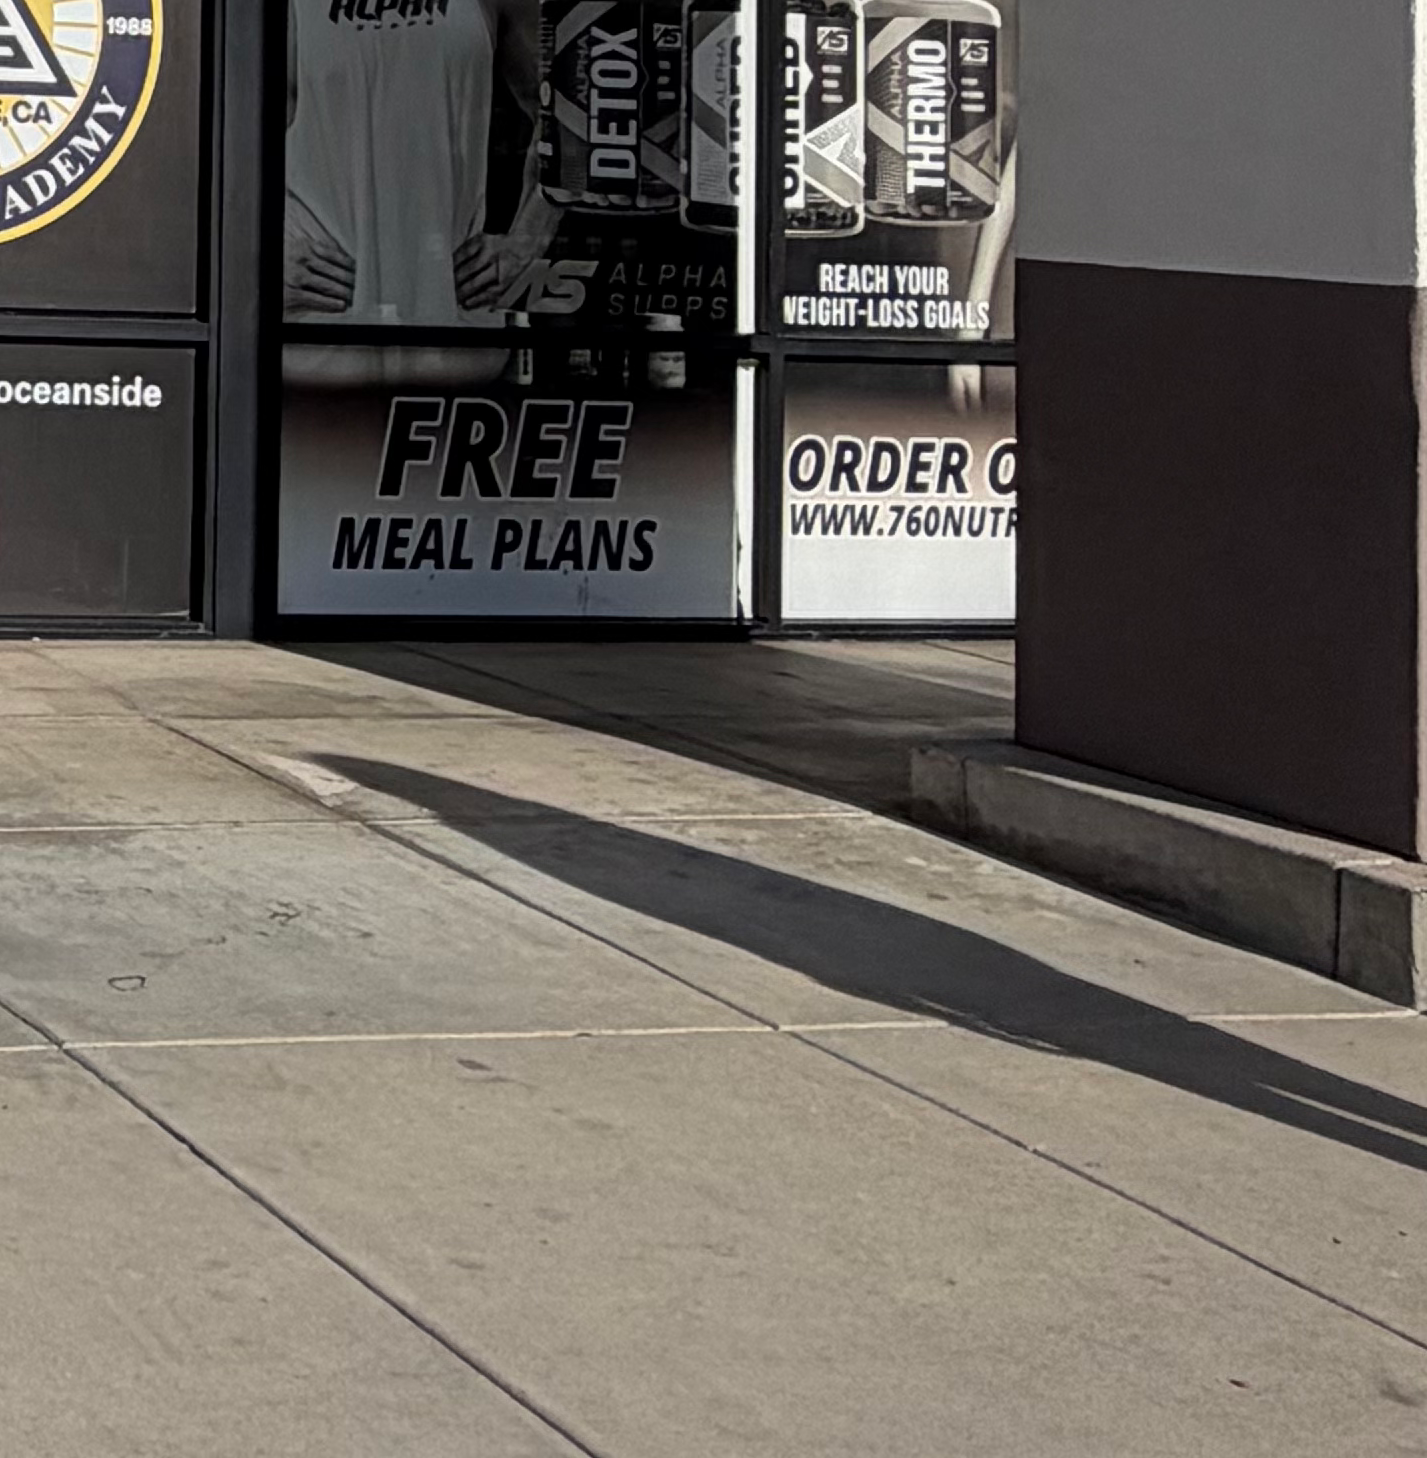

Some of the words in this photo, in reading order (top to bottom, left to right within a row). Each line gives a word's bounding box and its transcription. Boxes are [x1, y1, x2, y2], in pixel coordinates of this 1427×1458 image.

[106, 16, 153, 37] 1988
[12, 99, 52, 125] CA
[590, 26, 638, 179] DETOX
[906, 39, 947, 194] THERMO
[609, 262, 728, 288] ALPHA
[819, 263, 889, 293] REACH
[894, 265, 950, 295] YOUR
[608, 293, 729, 320] SUPPS
[923, 300, 990, 330] GOALS
[377, 397, 633, 501] FREE
[788, 437, 971, 494] ORDER
[332, 516, 474, 570] MEAL
[490, 518, 658, 572] PLANS
